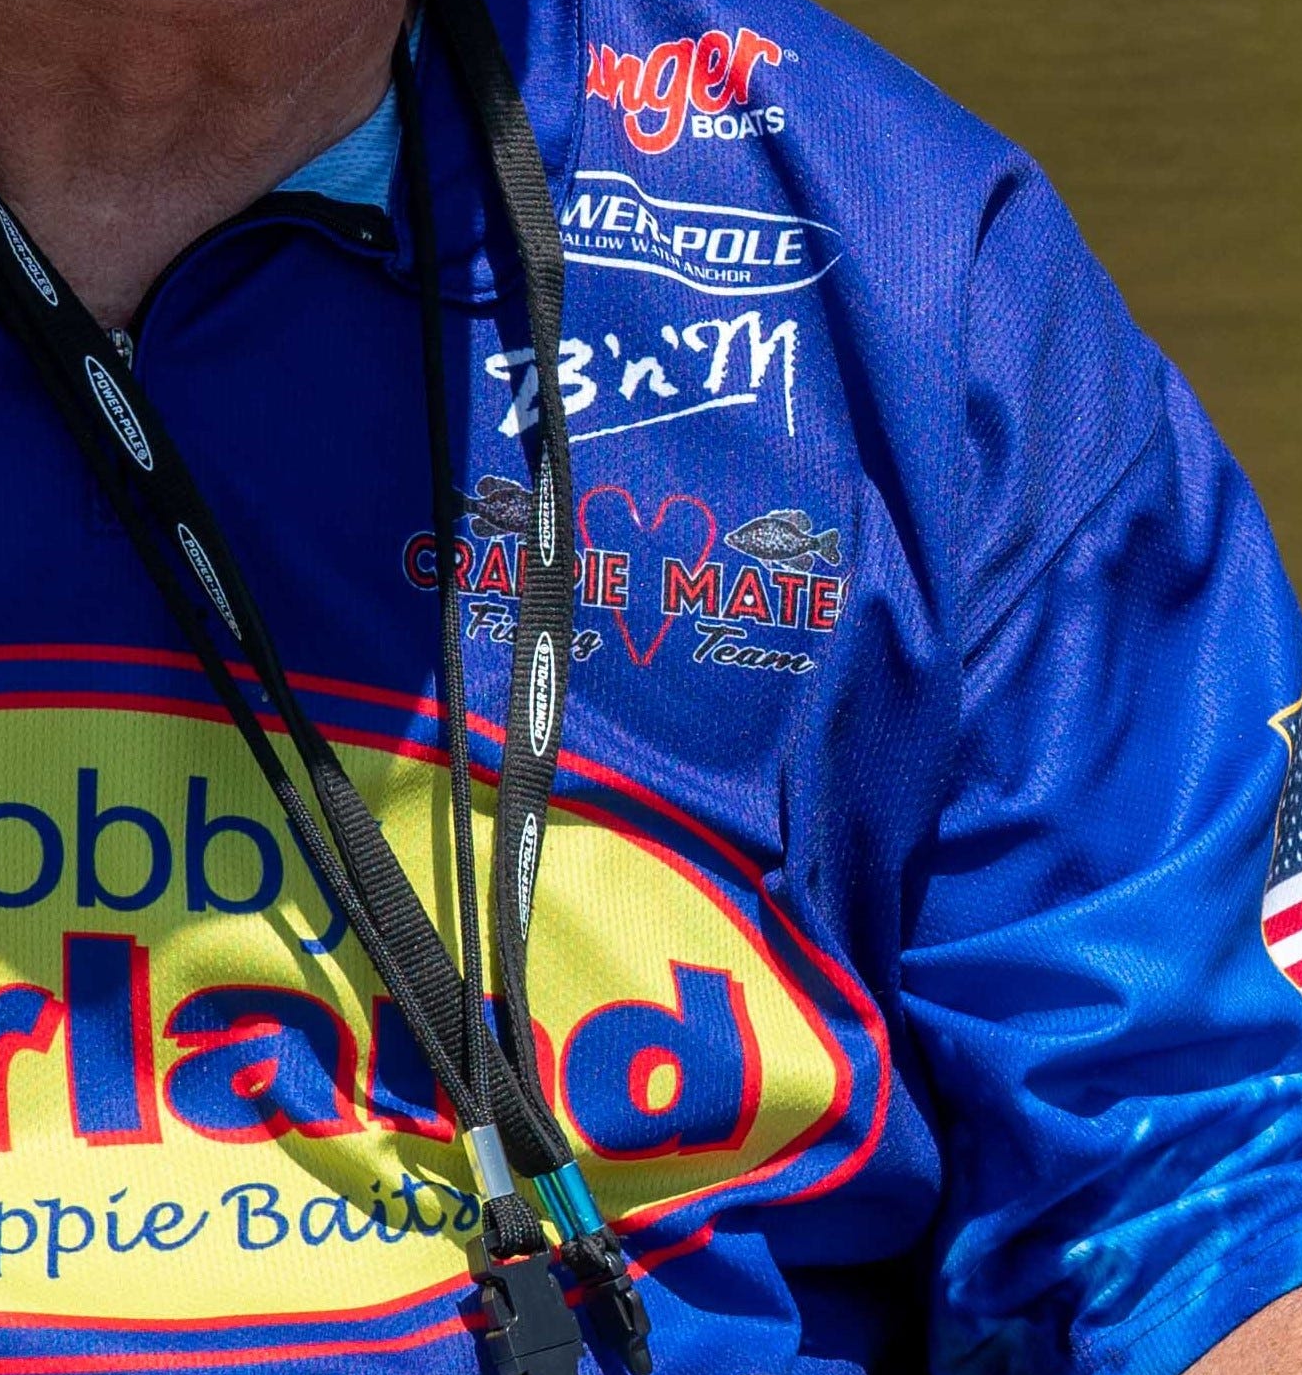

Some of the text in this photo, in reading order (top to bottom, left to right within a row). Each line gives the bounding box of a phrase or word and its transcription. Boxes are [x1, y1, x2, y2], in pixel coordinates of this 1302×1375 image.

[691, 105, 785, 141] BOATS
[683, 262, 751, 283] ANCHOR
[92, 370, 144, 448] POWER-POLE
[402, 531, 850, 633] CRAIE MATE
[694, 620, 816, 675] Team
[533, 654, 551, 740] POWER-POLE
[220, 1173, 483, 1251] Baits
